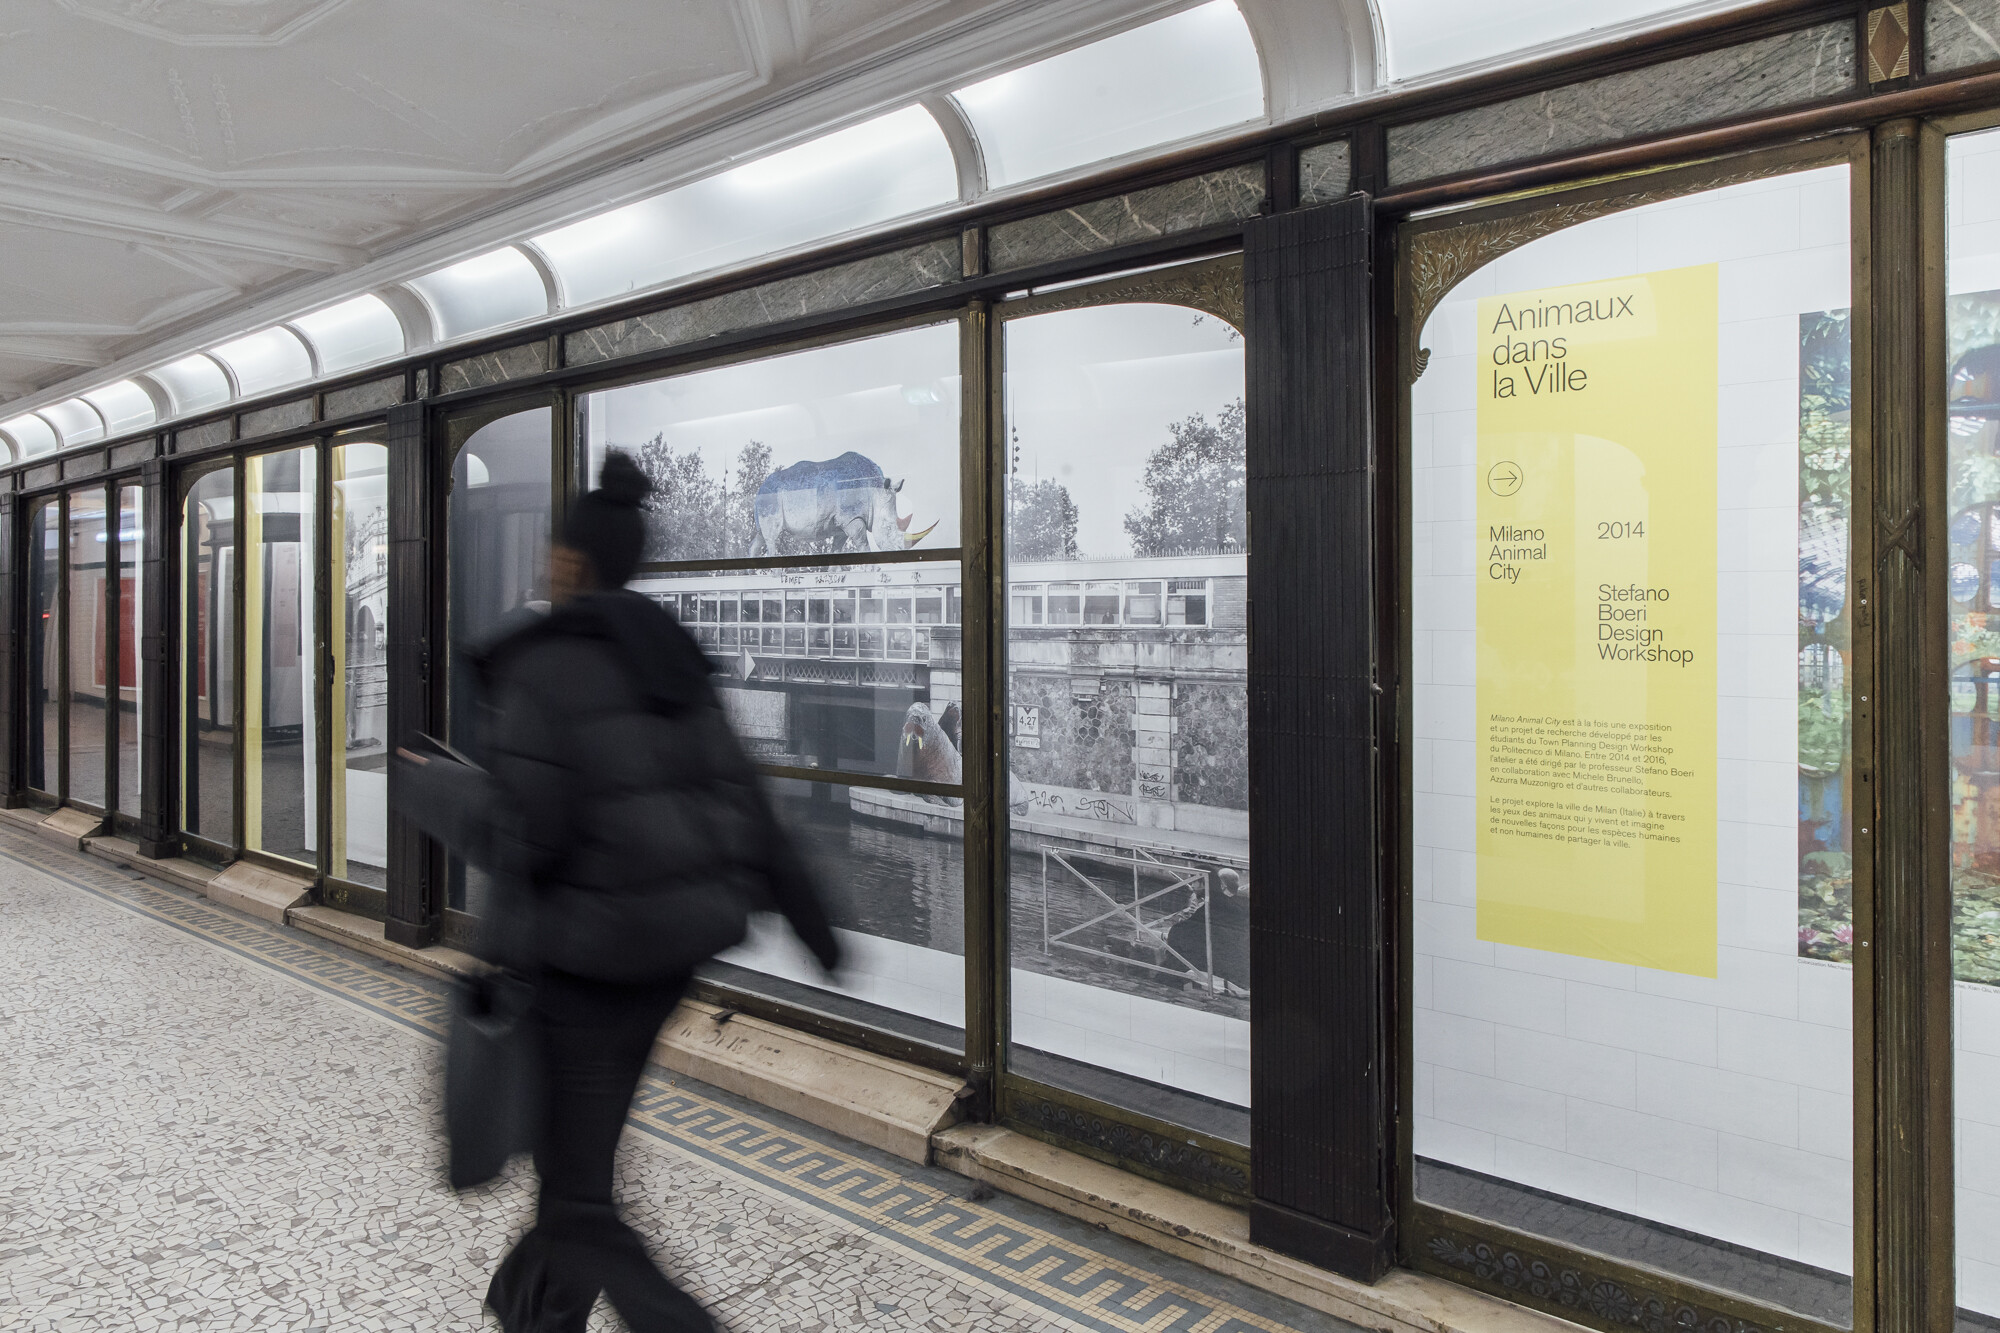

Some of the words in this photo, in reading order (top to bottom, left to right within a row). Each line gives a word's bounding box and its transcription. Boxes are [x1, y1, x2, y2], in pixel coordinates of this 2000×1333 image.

[1492, 295, 1633, 334] Animaux
[1493, 335, 1567, 365] dans
[1493, 370, 1516, 398] la
[1524, 362, 1587, 394] Ville
[1490, 525, 1544, 542] Milano
[1598, 521, 1645, 539] 2014
[1489, 544, 1546, 561] Animal
[1490, 563, 1521, 584] City
[1599, 584, 1669, 601] Stefano
[1599, 604, 1646, 621] Boeri
[1599, 624, 1663, 646] Design
[1598, 643, 1693, 668] Workshop
[1019, 716, 1036, 726] 4,27
[1490, 714, 1514, 722] Milano
[1516, 715, 1543, 724] Animal
[1545, 717, 1560, 727] City
[1594, 720, 1608, 728] fois
[1629, 723, 1672, 732] exposition
[1512, 727, 1532, 735] projet
[1547, 729, 1586, 737] recherche
[1589, 731, 1631, 740] développé
[1634, 734, 1647, 742] par
[1650, 734, 1662, 742] les
[1490, 735, 1524, 743] étudiants
[1539, 738, 1559, 746] Town
[1562, 739, 1596, 750] Planning
[1599, 742, 1627, 752] Design
[1631, 744, 1673, 755] Workshop
[1502, 746, 1543, 755] Politecnico
[1555, 749, 1582, 758] Milano.
[1585, 751, 1606, 760] Entre
[1609, 753, 1629, 761] 2014
[1644, 755, 1667, 765] 2016,
[1502, 767, 1550, 776] collaboration
[1553, 771, 1570, 779] avec
[1573, 771, 1604, 781] Michele
[1607, 774, 1643, 785] Brunello,
[1540, 759, 1561, 768] dirigé
[1565, 762, 1576, 770] par
[1589, 763, 1632, 772] professeur
[1636, 765, 1668, 775] Stefano
[1671, 768, 1694, 777] Boeri
[1490, 775, 1518, 784] Azzurra
[1520, 778, 1563, 789] Muzzonigro
[1611, 786, 1672, 798] collaborateurs.
[1502, 797, 1523, 807] projet
[1526, 800, 1554, 808] explore
[1596, 805, 1617, 814] Milan
[1620, 807, 1646, 818] (Italie)
[1657, 812, 1685, 821] travers
[1502, 818, 1536, 827] nouvelles
[1540, 821, 1565, 830] façons
[1568, 825, 1585, 833] pour
[1588, 826, 1599, 834] les
[1602, 829, 1636, 838] espèces
[1639, 832, 1680, 843] humaines
[1539, 812, 1571, 820] animaux
[1595, 817, 1618, 825] vivent
[1621, 819, 1629, 827] et
[1632, 821, 1664, 831] imagine
[1516, 829, 1552, 839] humaines
[1568, 835, 1601, 846] partager
[1604, 838, 1610, 846] la
[1613, 840, 1630, 848] ville.
